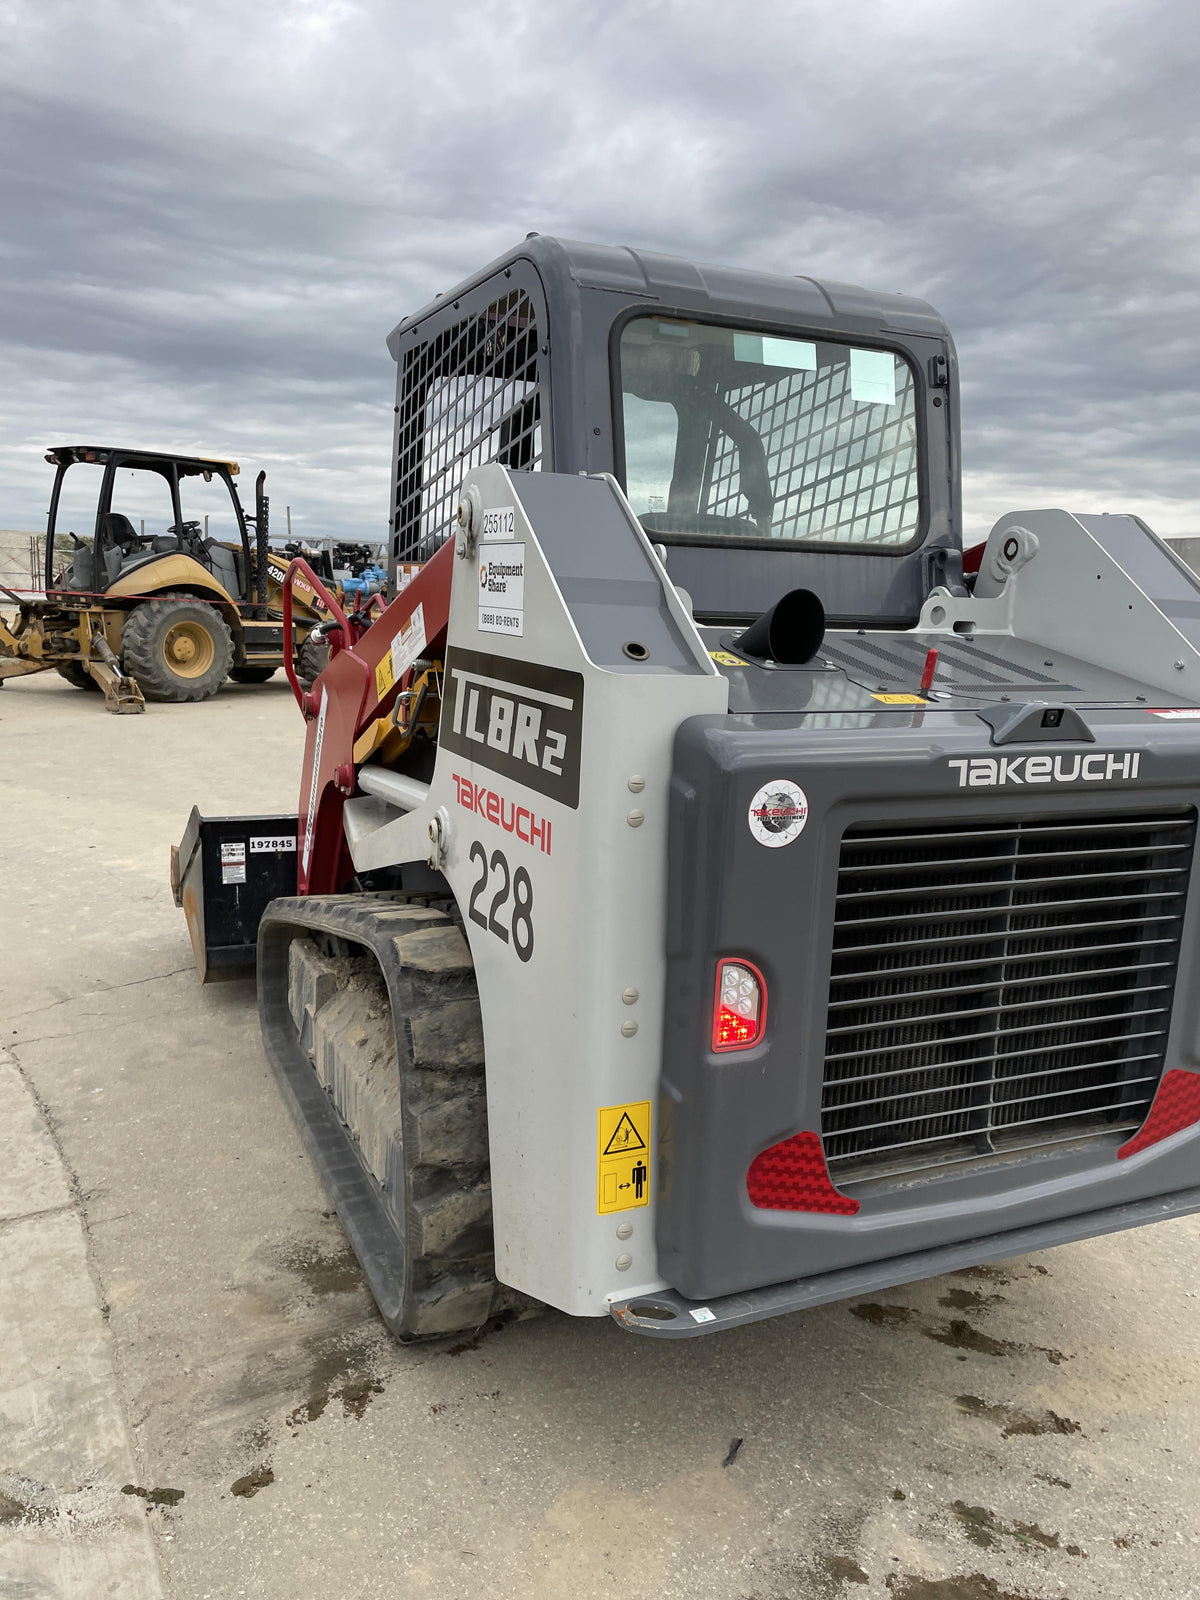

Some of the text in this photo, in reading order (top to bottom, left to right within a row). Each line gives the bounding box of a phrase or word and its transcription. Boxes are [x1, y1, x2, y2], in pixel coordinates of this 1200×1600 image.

[483, 512, 514, 534] 255112
[488, 562, 524, 579] Equipment
[488, 579, 507, 593] Share
[481, 613, 495, 626] (888)
[948, 752, 1141, 788] TAKEUCHI
[452, 773, 552, 856] TAKEUCHI
[250, 840, 293, 849] 197845
[468, 840, 534, 963] 228
